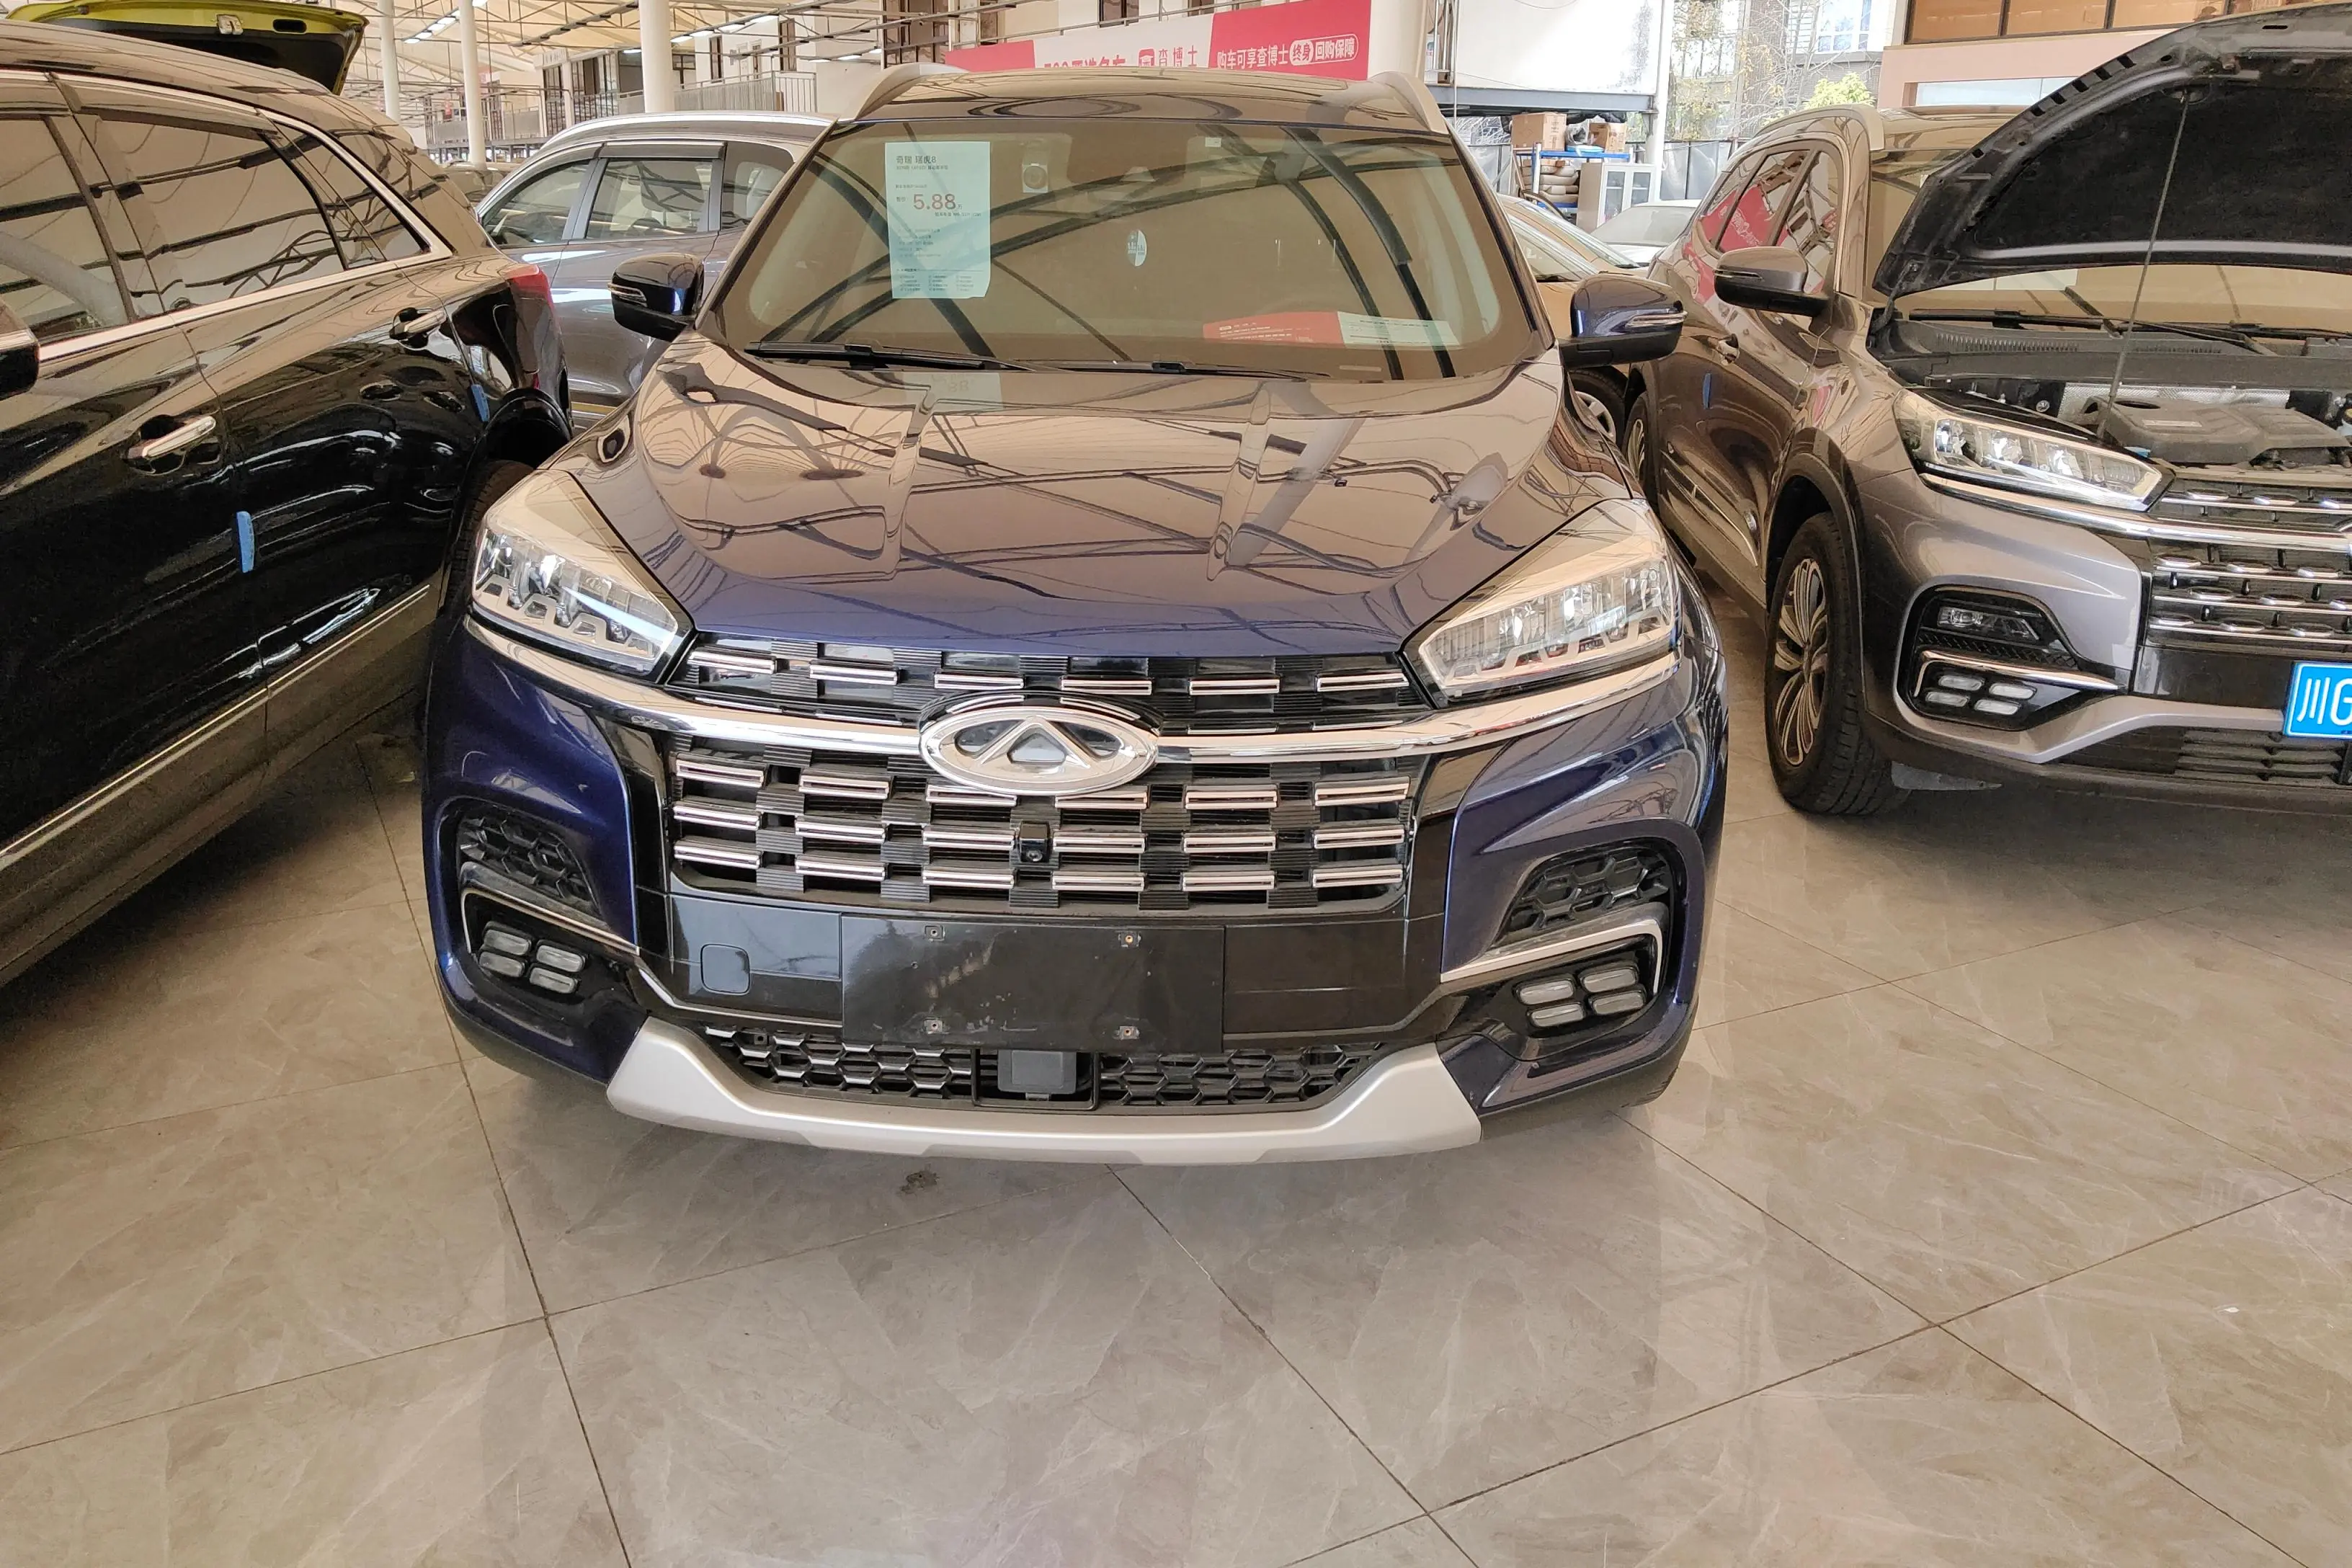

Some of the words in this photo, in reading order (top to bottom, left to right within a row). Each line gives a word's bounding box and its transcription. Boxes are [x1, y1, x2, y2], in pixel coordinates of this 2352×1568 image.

[1158, 45, 1198, 67] 查博士
[913, 193, 956, 210] 5.88
[2296, 677, 2352, 726] 川G
